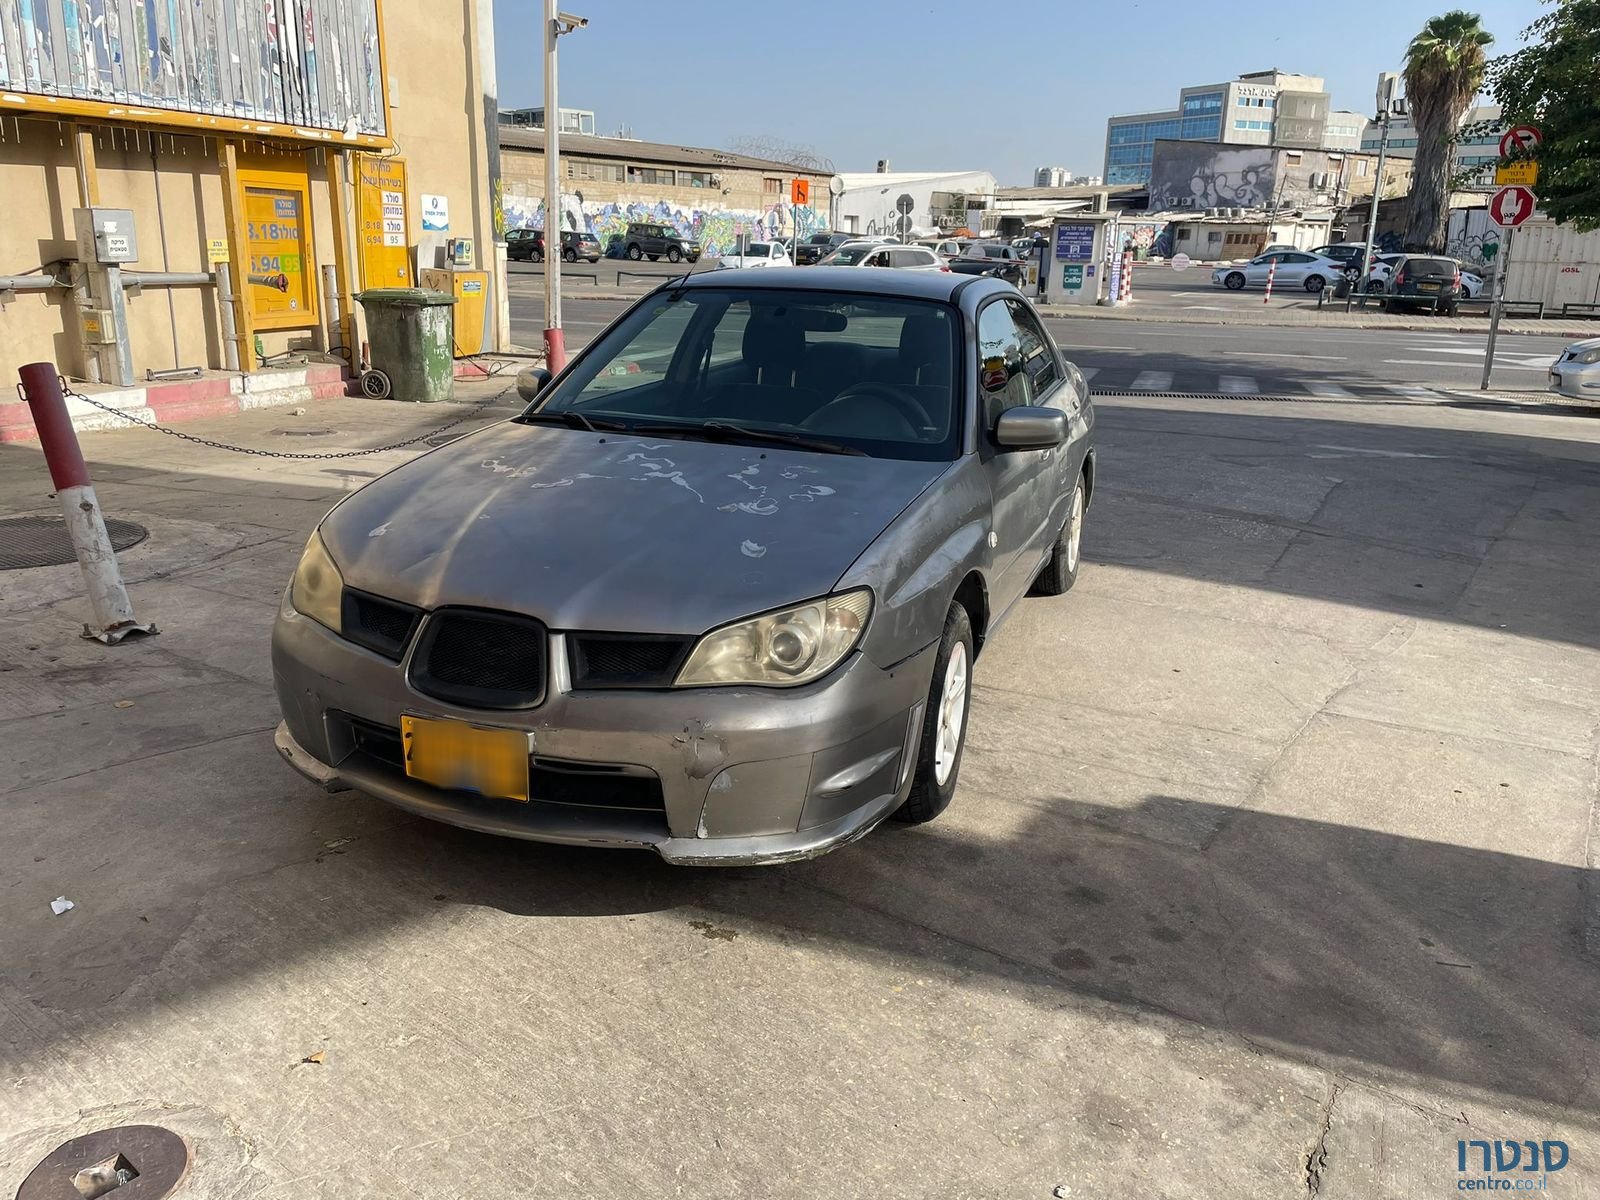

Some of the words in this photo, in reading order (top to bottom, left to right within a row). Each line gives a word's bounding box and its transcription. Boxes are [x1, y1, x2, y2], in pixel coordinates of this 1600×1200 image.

[370, 162, 390, 173] מחרון
[386, 193, 400, 203] סולר
[278, 200, 292, 208] סולר
[384, 206, 402, 216] במזומן
[366, 222, 380, 230] 8.18
[386, 221, 401, 231] סולר
